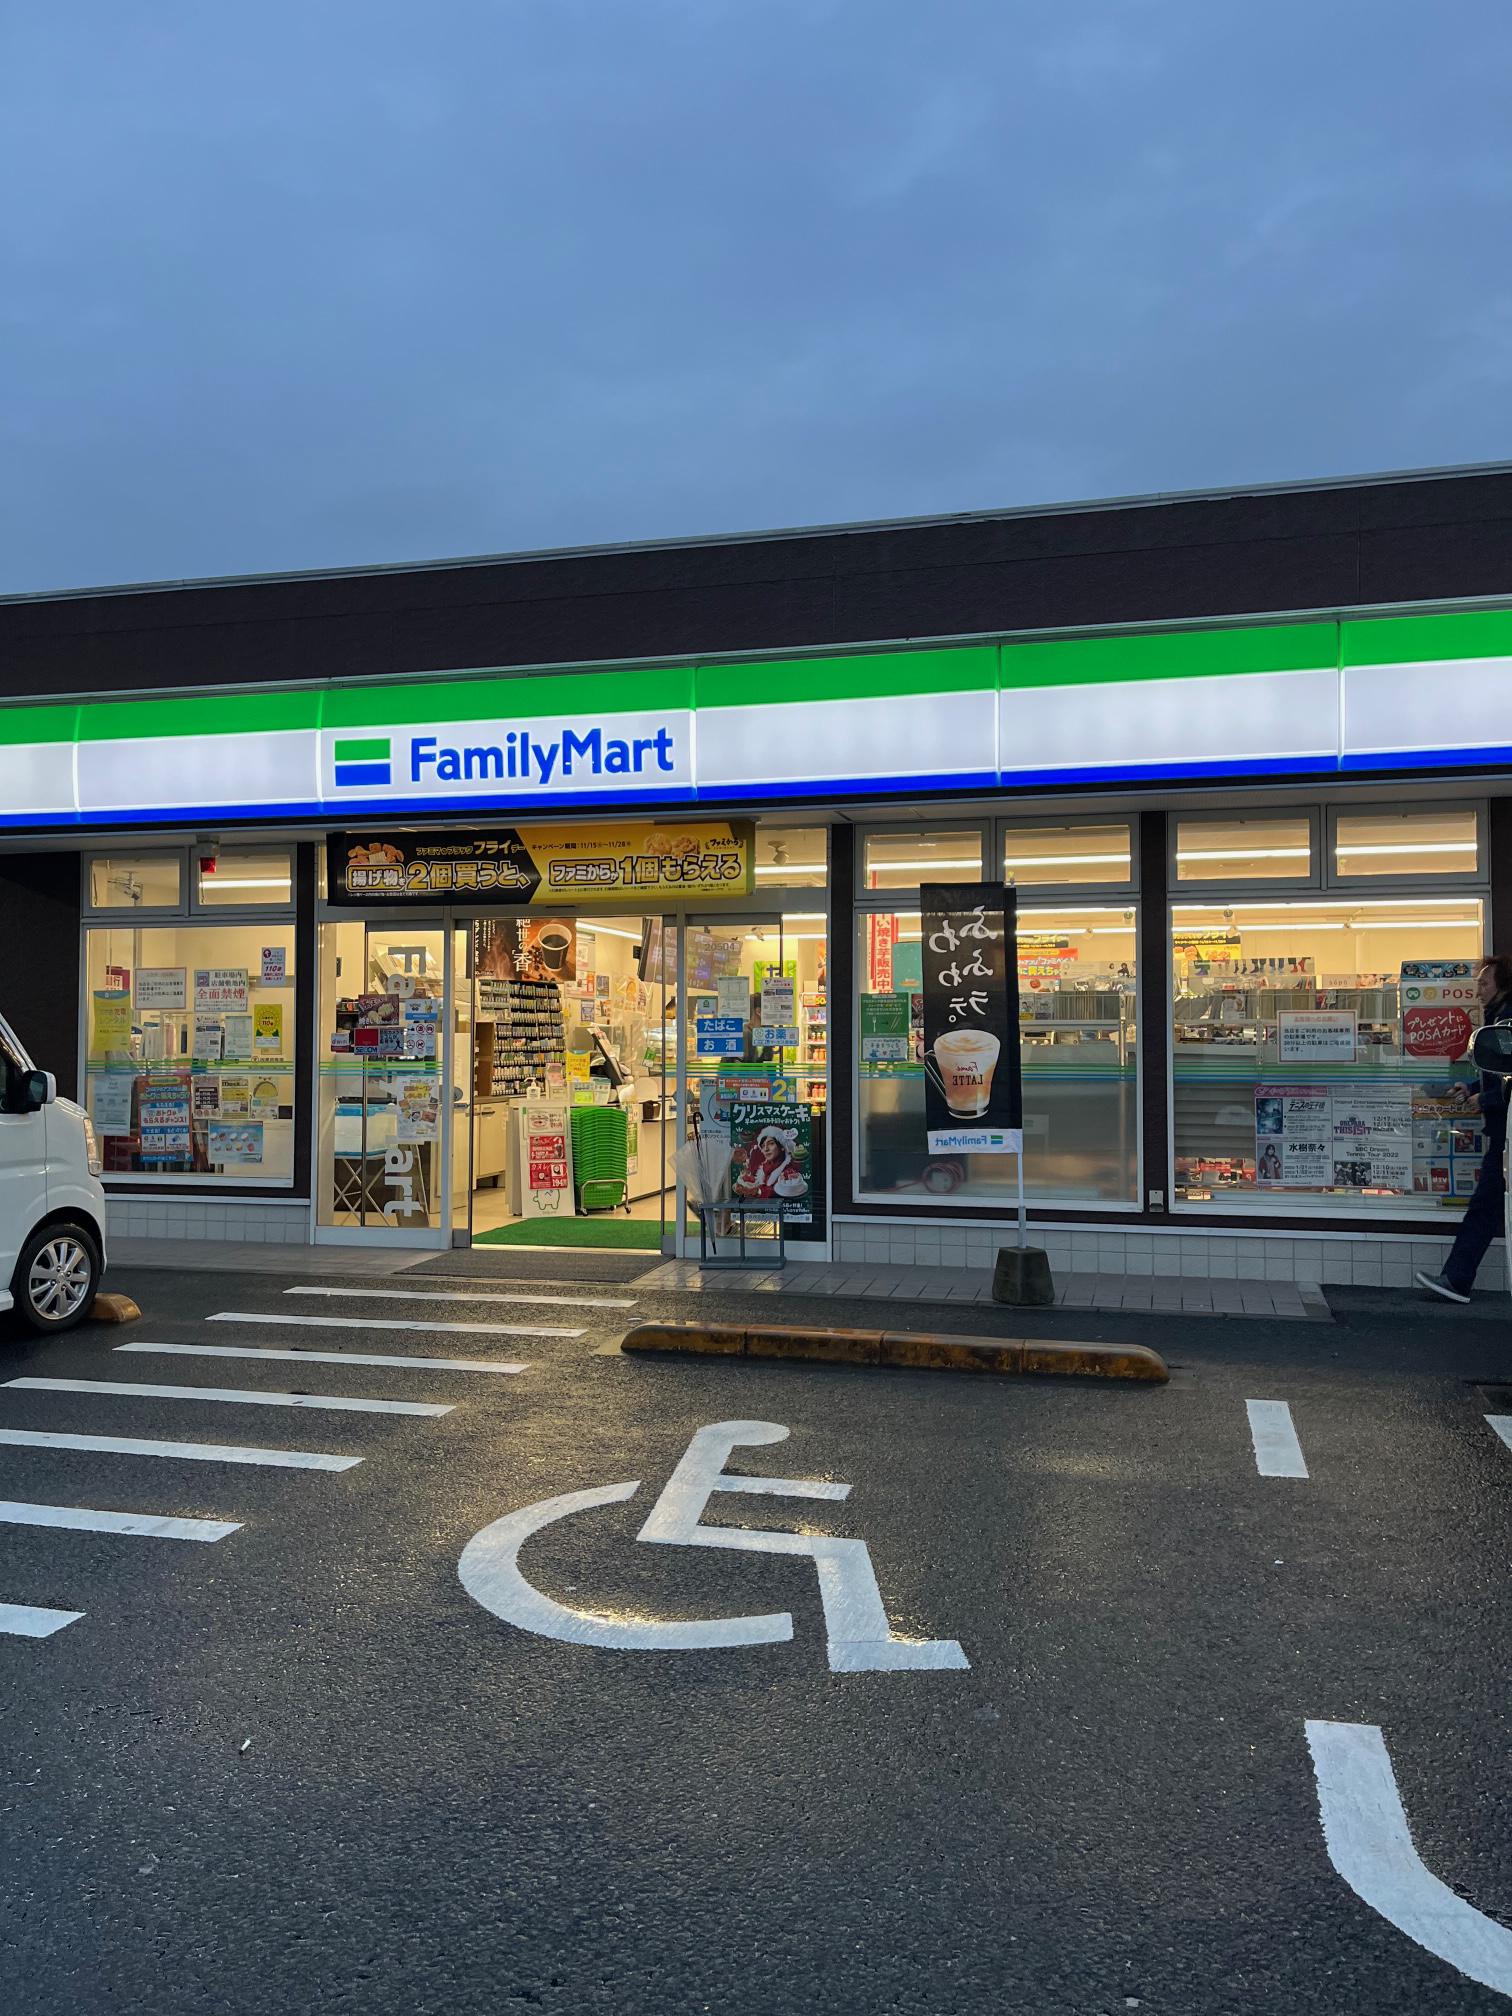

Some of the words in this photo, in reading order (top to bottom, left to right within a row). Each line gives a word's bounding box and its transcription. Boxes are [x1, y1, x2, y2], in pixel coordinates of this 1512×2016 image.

[411, 727, 674, 783] FamilyMart
[197, 988, 245, 1000] 全面禁煙
[703, 1019, 736, 1031] たばこ
[1408, 1011, 1464, 1029] プレゼントに
[1409, 1024, 1466, 1043] POSAカード
[1289, 1143, 1326, 1152] 水樹奈々
